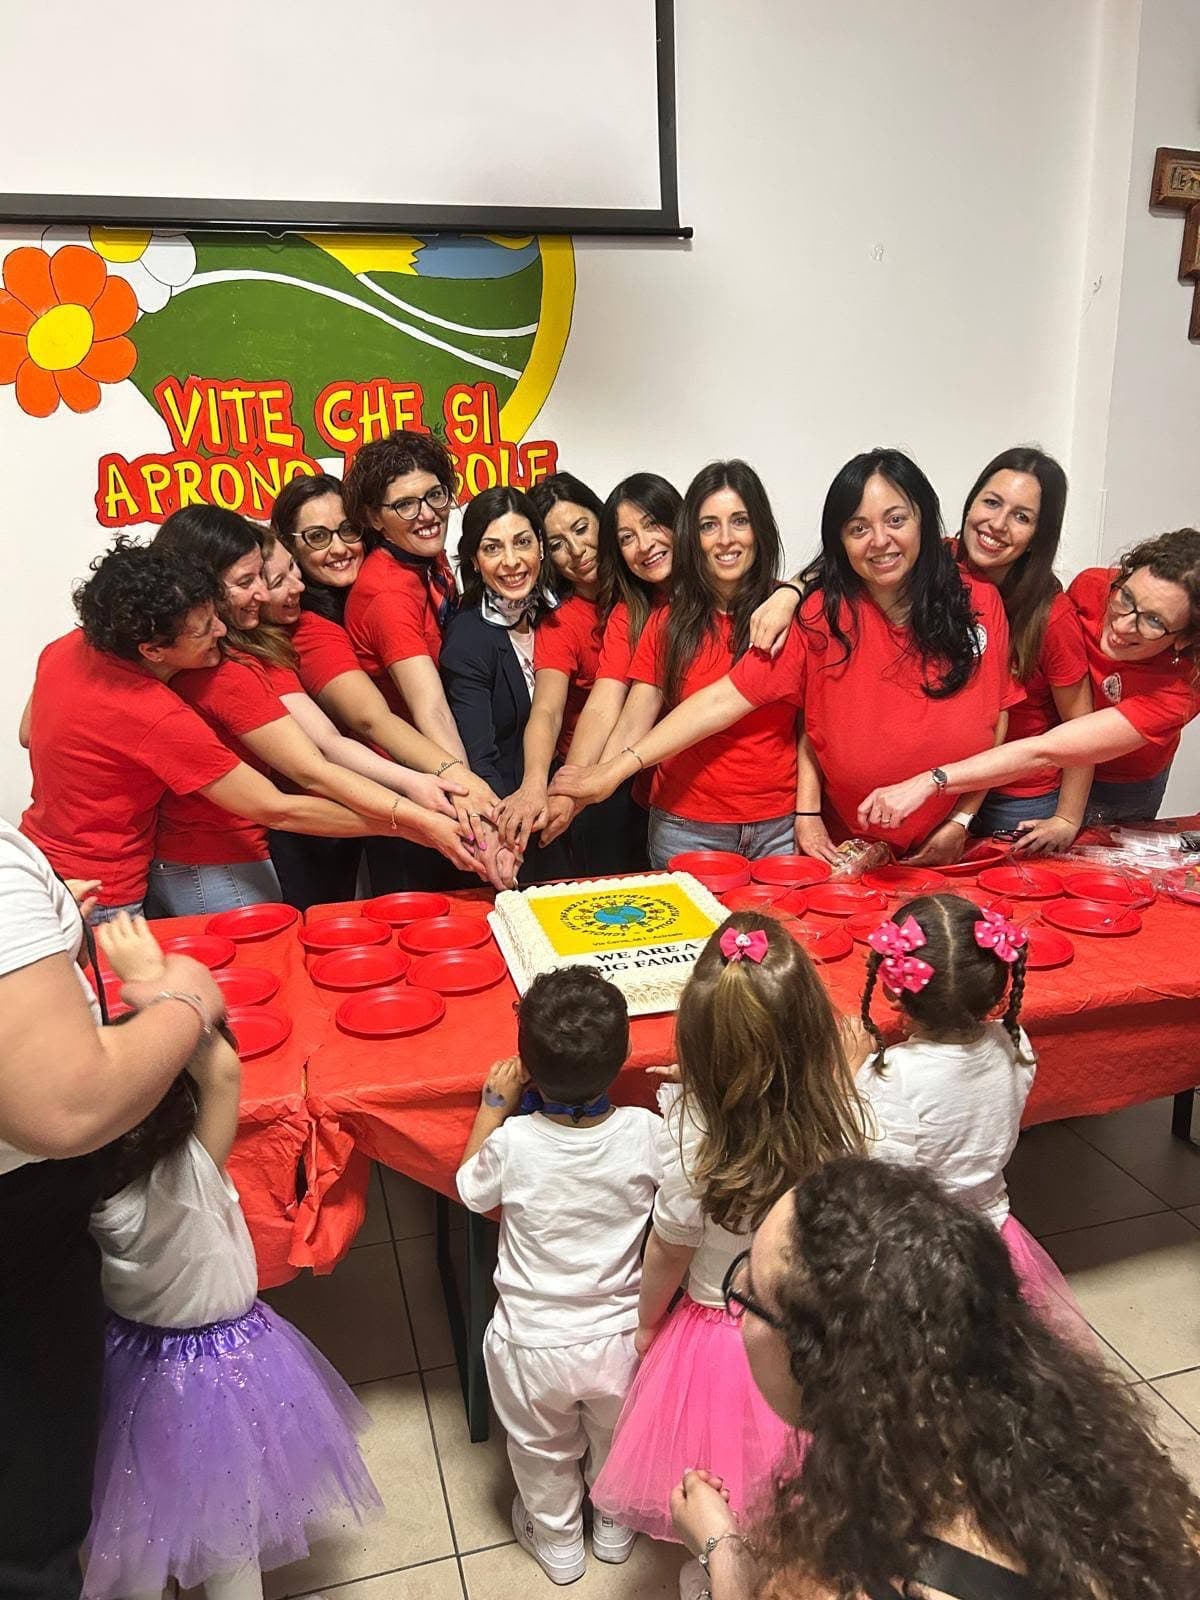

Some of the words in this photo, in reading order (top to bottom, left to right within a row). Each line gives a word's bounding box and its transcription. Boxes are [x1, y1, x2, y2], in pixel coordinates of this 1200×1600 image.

[164, 385, 297, 447] VITE
[322, 385, 417, 443] CHE
[451, 389, 492, 445] SI
[595, 951, 631, 962] WE
[637, 945, 680, 957] ARE
[684, 943, 699, 951] A
